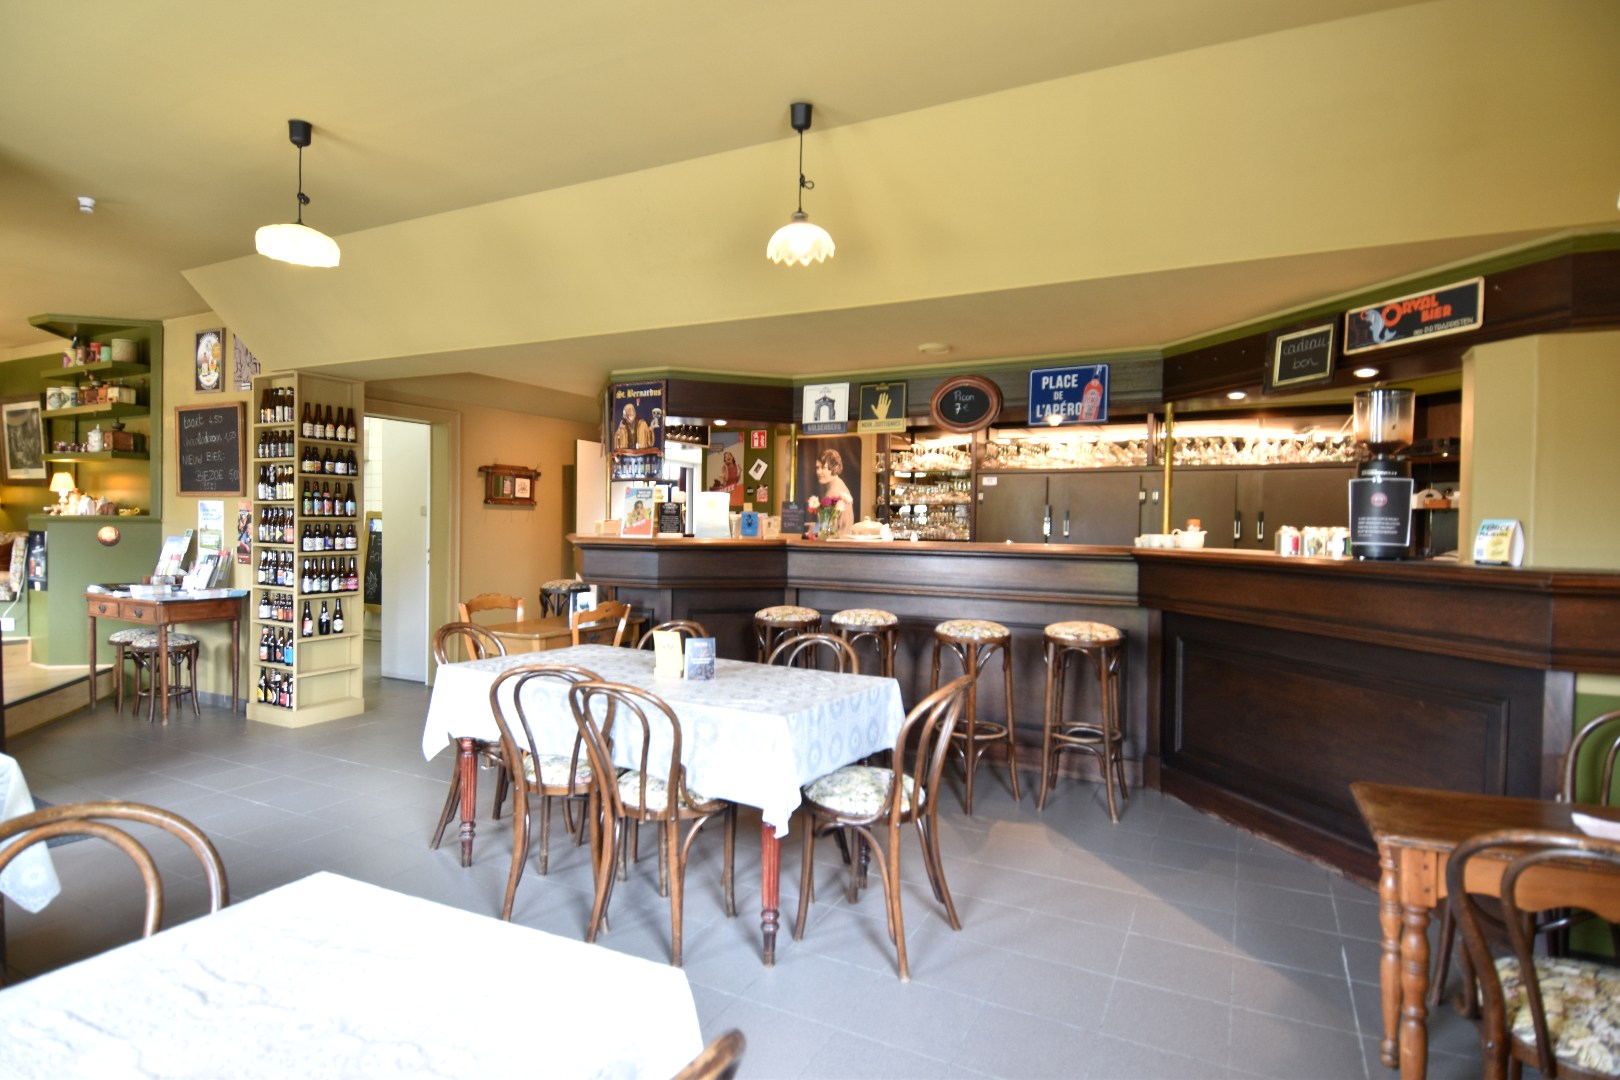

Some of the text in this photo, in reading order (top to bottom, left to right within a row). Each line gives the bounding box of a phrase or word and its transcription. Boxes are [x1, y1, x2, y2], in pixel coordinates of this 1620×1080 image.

[1292, 357, 1319, 369] bon
[1041, 373, 1078, 390] PLACE
[627, 388, 662, 398] Bernardus
[954, 390, 976, 402] Picon
[1053, 390, 1064, 401] DE
[1036, 400, 1083, 418] L'APÉRO
